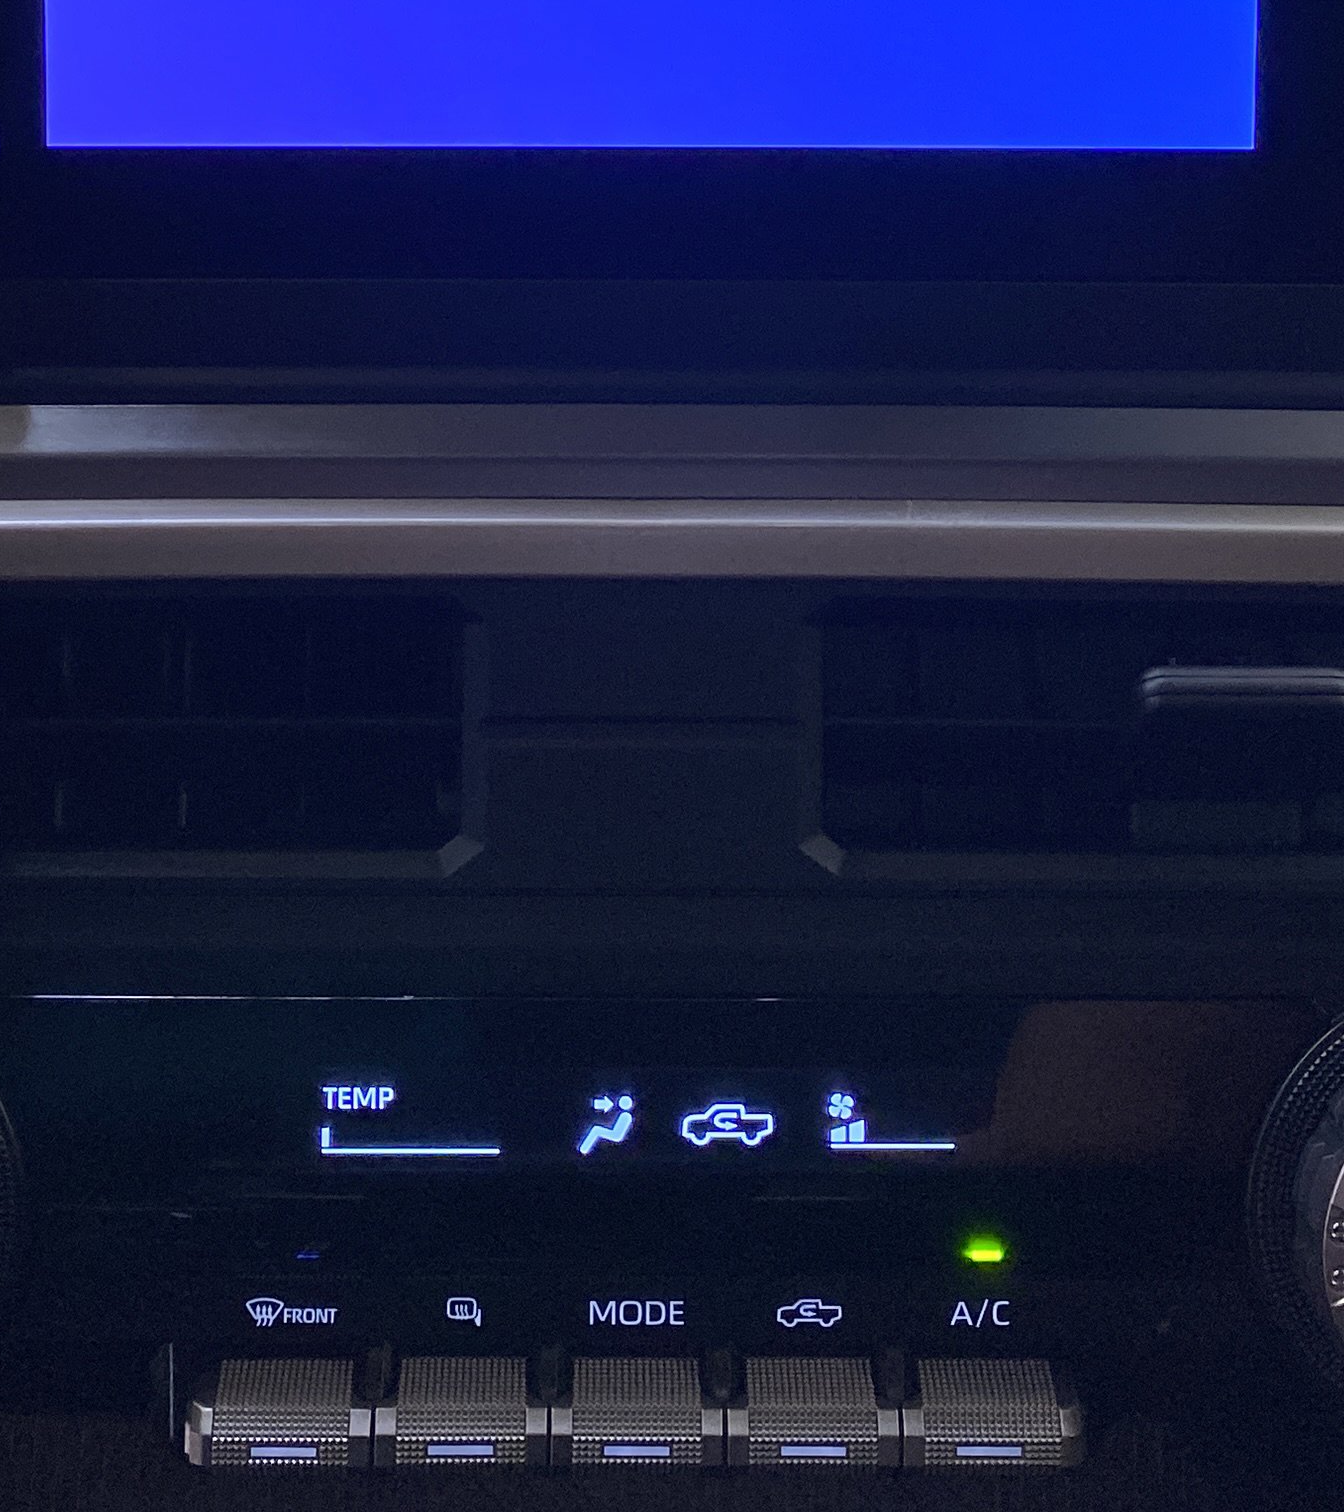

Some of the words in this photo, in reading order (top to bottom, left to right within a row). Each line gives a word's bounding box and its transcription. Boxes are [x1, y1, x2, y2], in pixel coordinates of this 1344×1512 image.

[322, 1086, 395, 1110] TEMP
[283, 1306, 338, 1324] FRONT
[589, 1300, 685, 1326] MODE
[950, 1299, 1010, 1328] A/C
